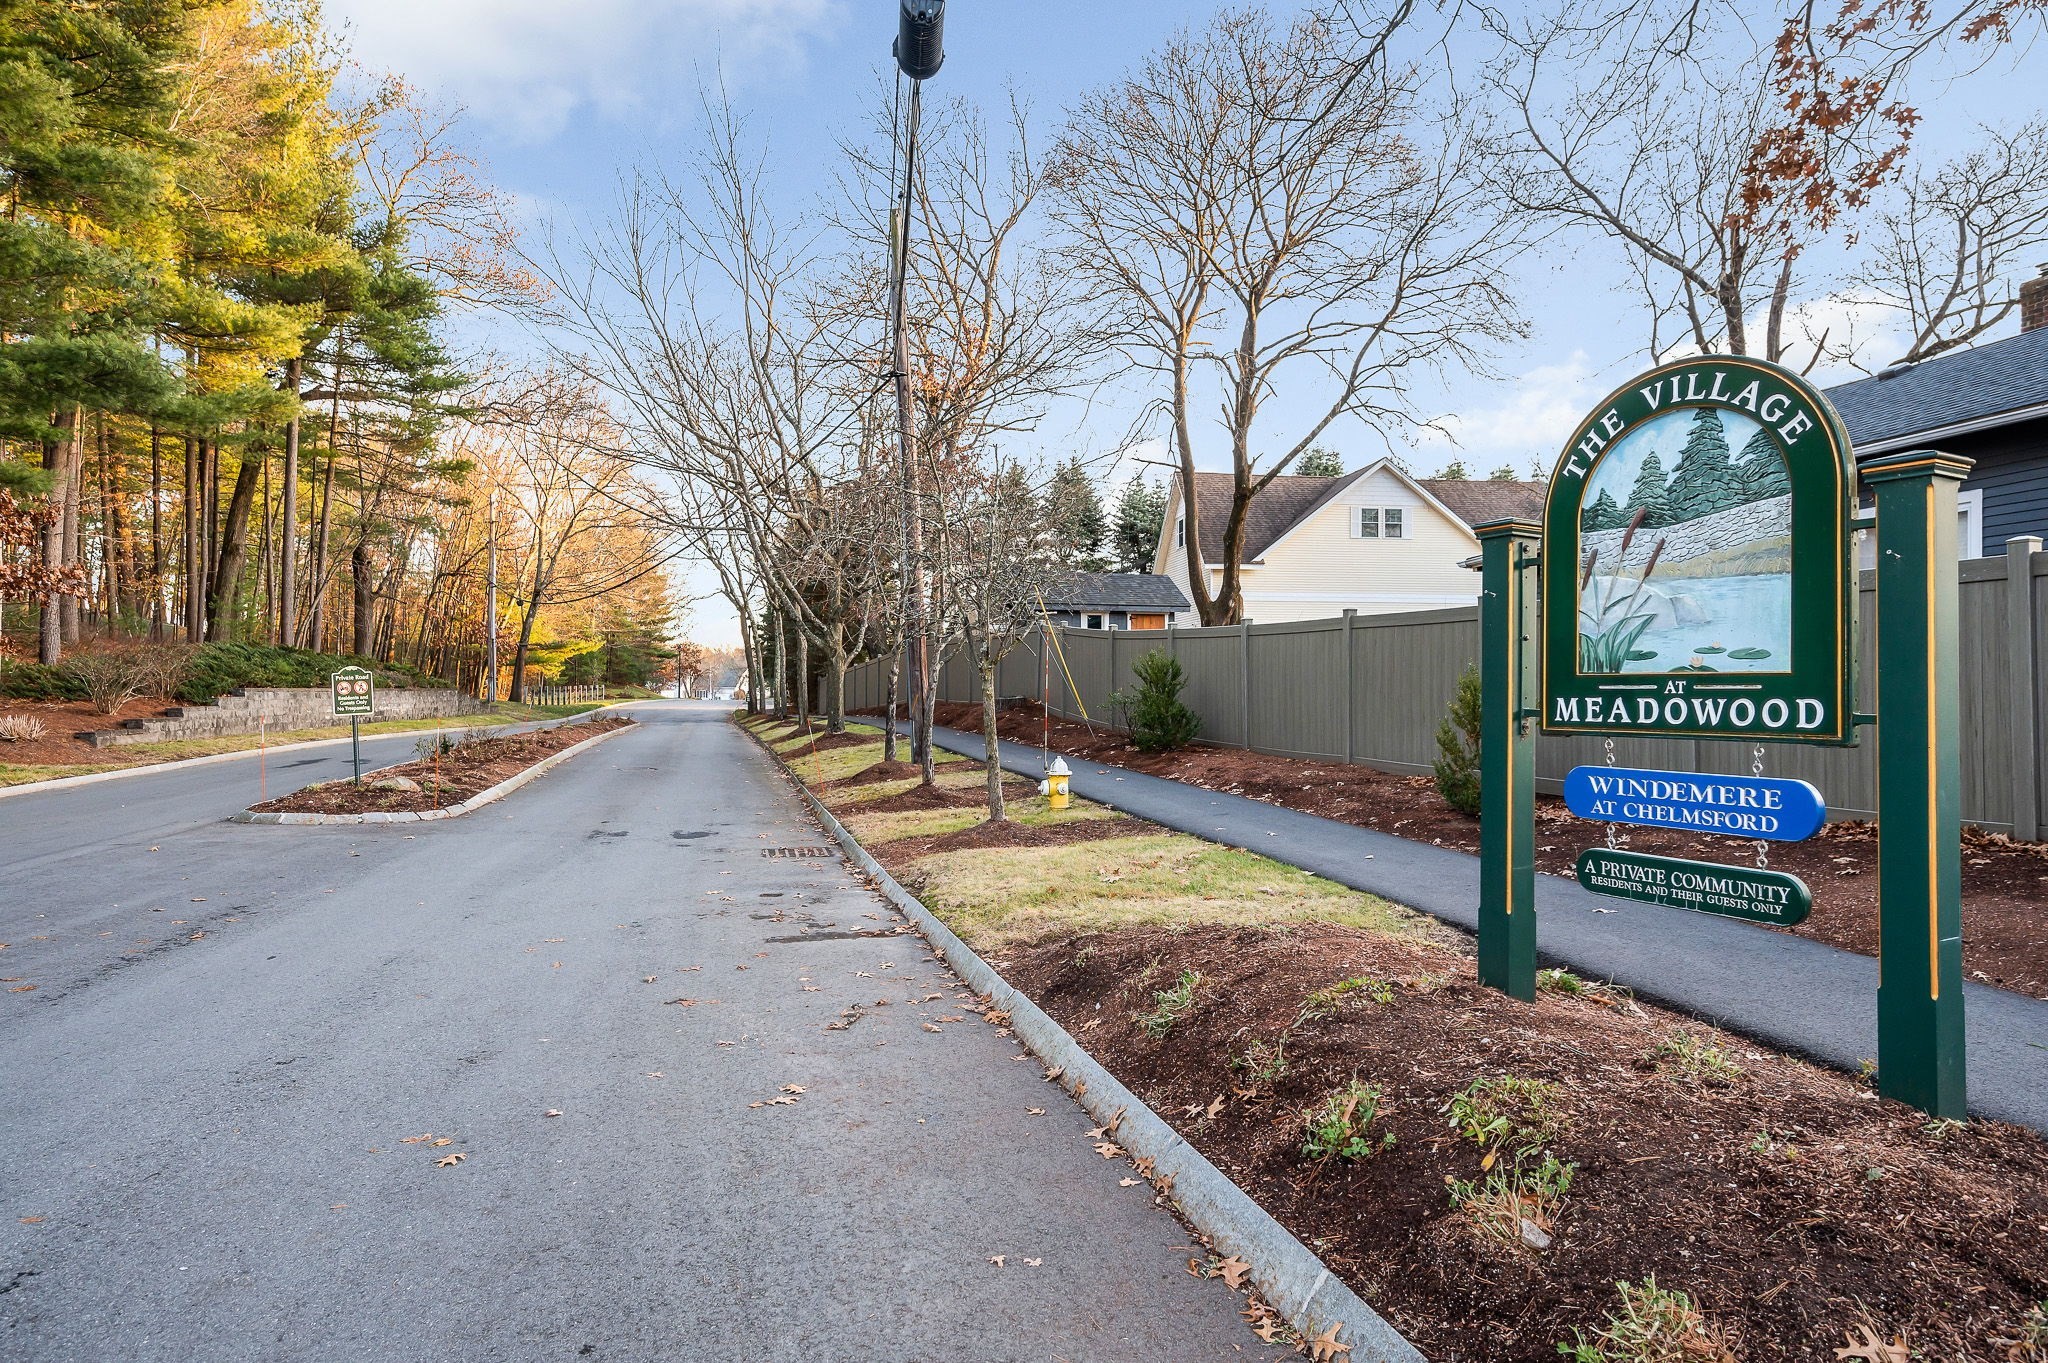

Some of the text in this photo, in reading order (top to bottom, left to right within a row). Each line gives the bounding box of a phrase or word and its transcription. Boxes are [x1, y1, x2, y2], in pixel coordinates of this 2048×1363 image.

[1562, 372, 1813, 479] THE VILLAGE
[1664, 680, 1687, 694] AT
[1554, 696, 1825, 729] MEADOWOOD
[1587, 775, 1783, 811] WINDEMERE
[1590, 800, 1779, 833] AT CHELMSFORD
[1584, 859, 1791, 904] A PRIVATE COMMUNITY
[1591, 876, 1783, 916] RESIDENTS AND THEIR GUESTS ONLY
